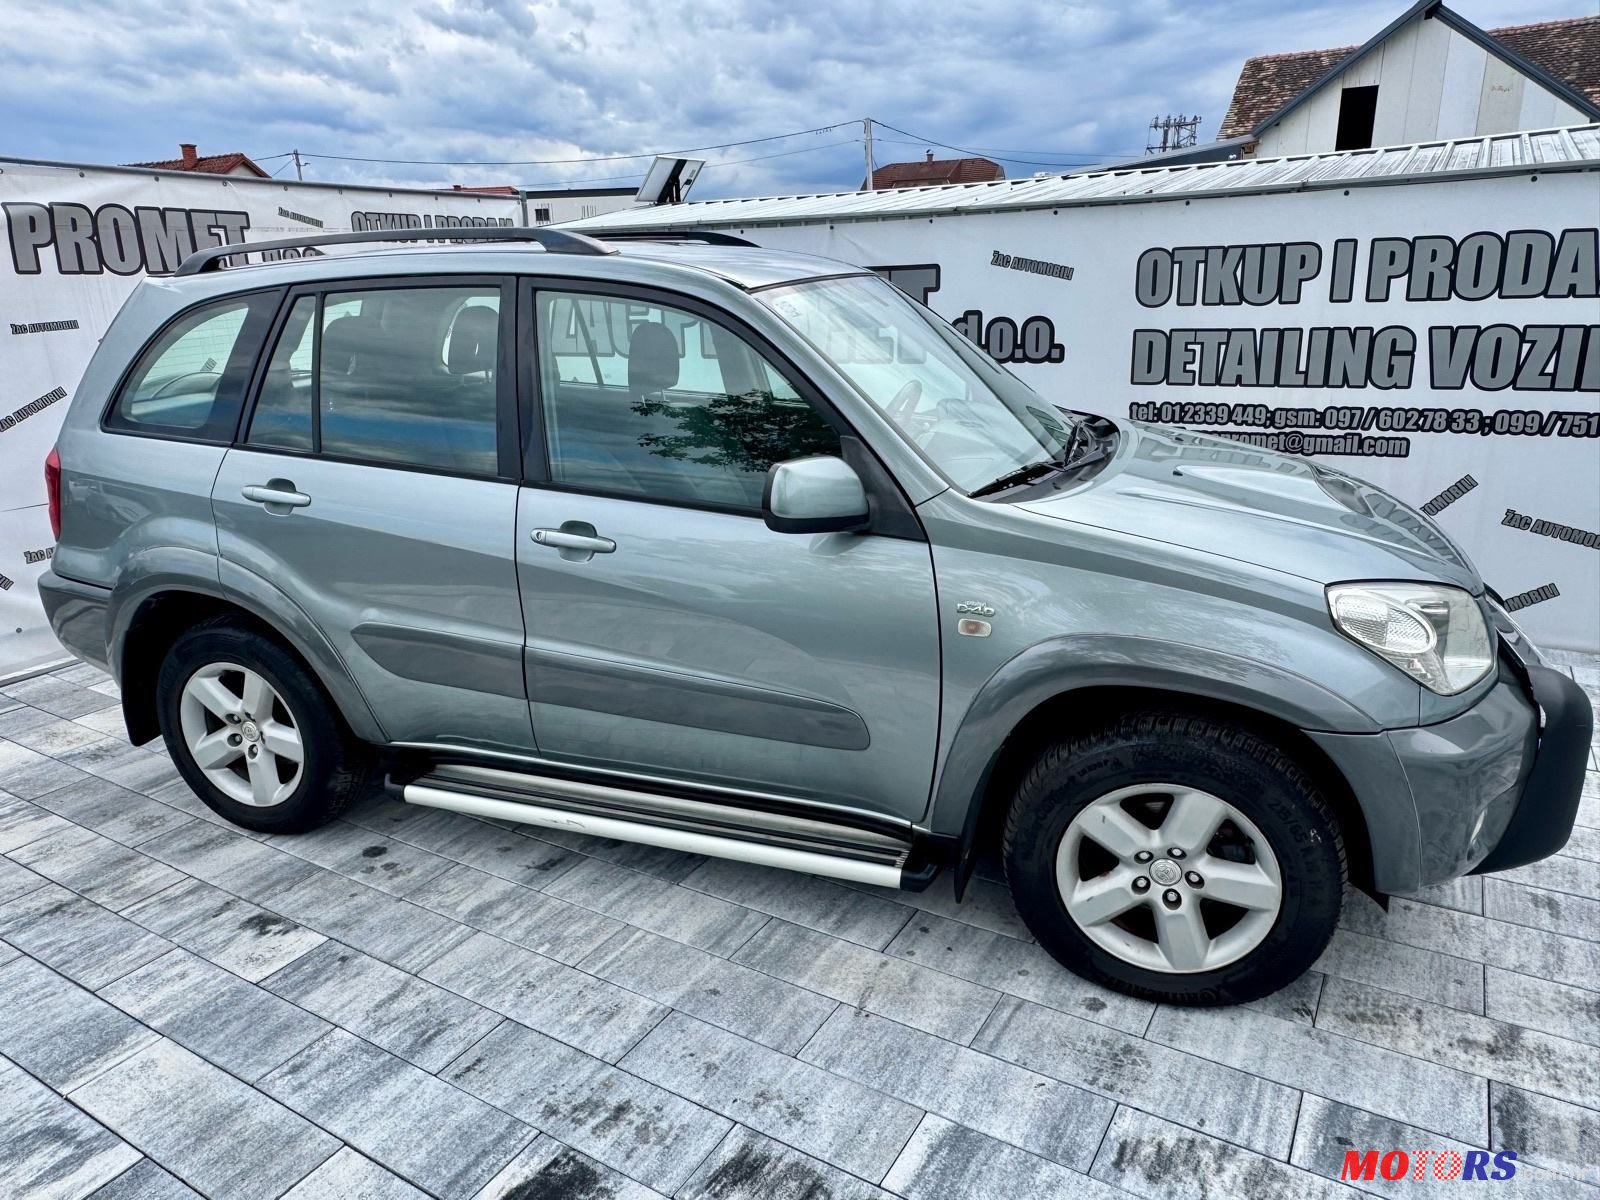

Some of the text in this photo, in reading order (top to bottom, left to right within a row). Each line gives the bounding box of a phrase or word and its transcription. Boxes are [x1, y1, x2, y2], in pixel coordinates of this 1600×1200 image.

[2, 201, 250, 276] PROMET
[1010, 257, 1074, 281] AUTOMOBILI
[1135, 228, 1600, 307] OTKUP I PRODA
[28, 320, 79, 333] AUTOMOBILI
[1130, 324, 1600, 392] DETAILING VOZI
[12, 386, 67, 423] AUTOMOBILI
[1129, 402, 1158, 422] tel:
[1273, 408, 1322, 427] gsm:
[1501, 509, 1533, 531] ŽAC
